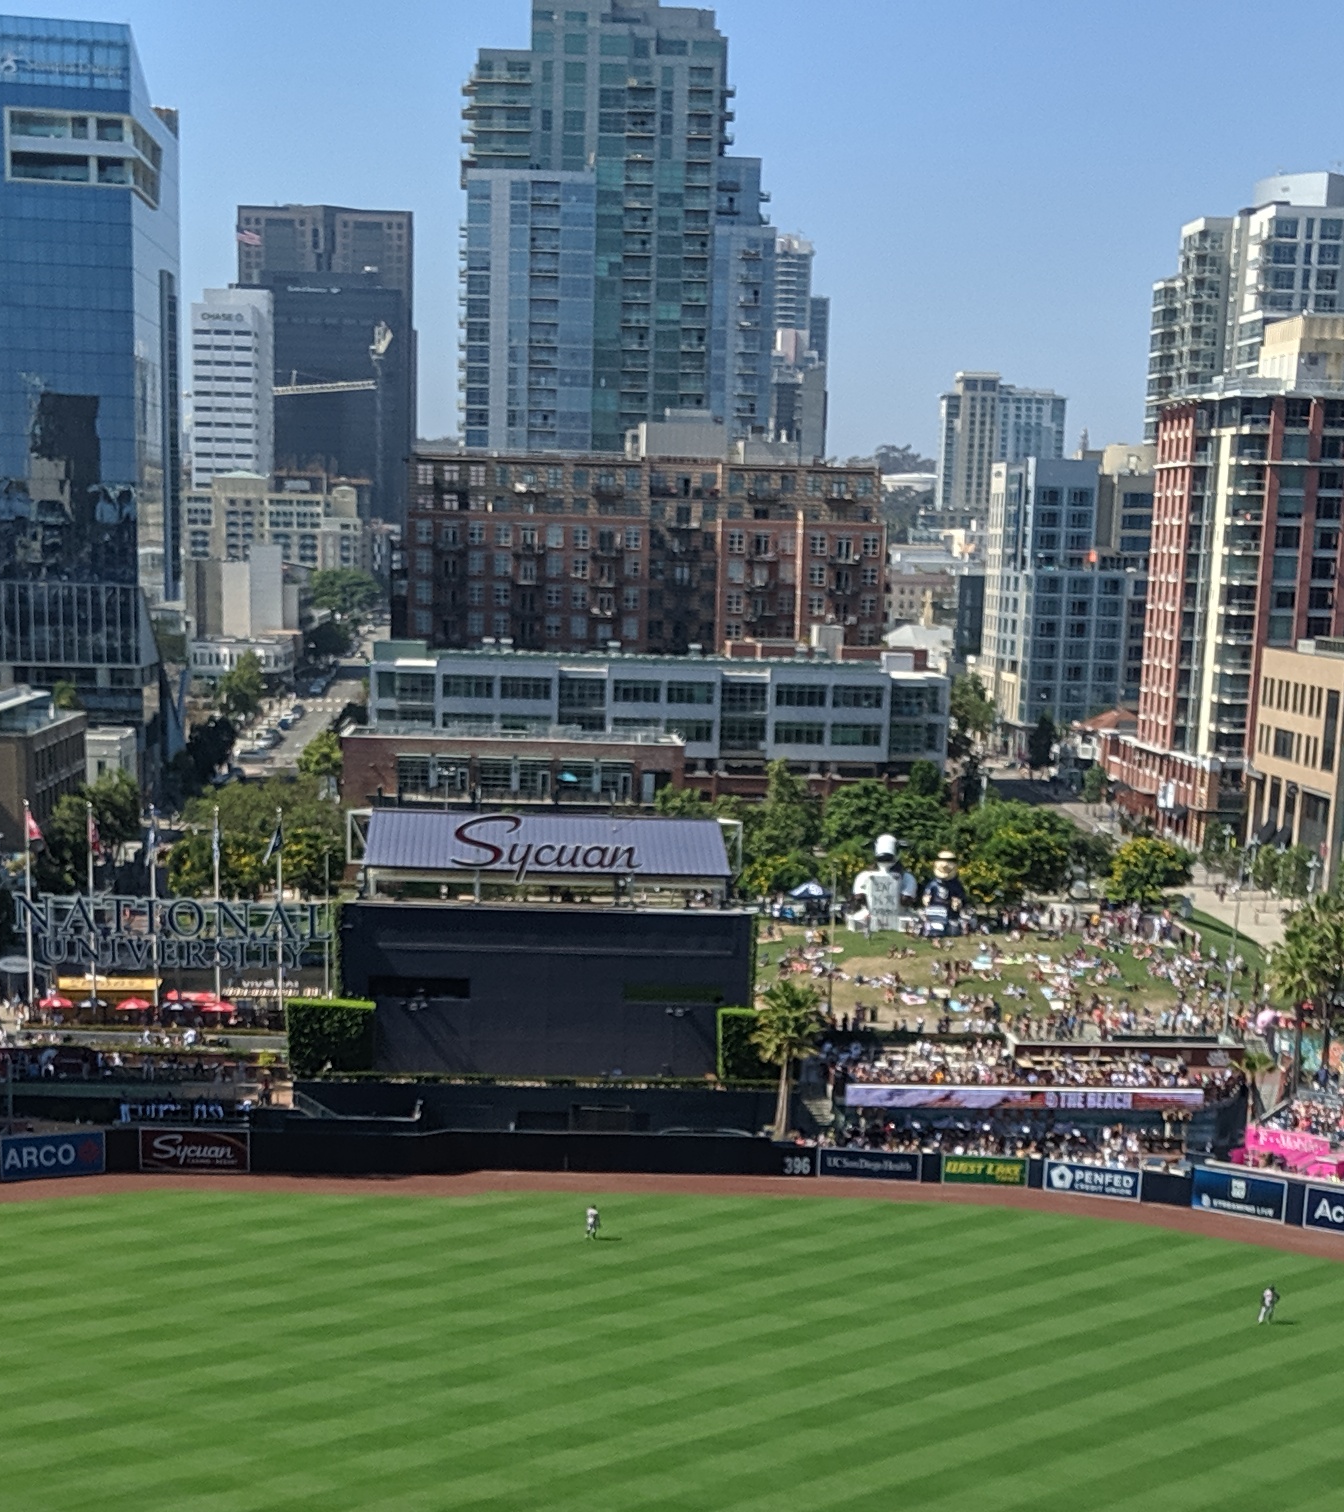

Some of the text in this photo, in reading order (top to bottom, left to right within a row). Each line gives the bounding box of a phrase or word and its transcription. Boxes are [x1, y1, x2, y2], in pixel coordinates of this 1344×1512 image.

[452, 814, 642, 884] Sycuan
[12, 893, 333, 941] NATIONAL
[39, 934, 310, 971] UNIVERSITY
[5, 1143, 76, 1170] ARCO
[152, 1134, 236, 1169] Sycuan
[783, 1156, 811, 1175] 396
[1074, 1169, 1135, 1189] PENFED
